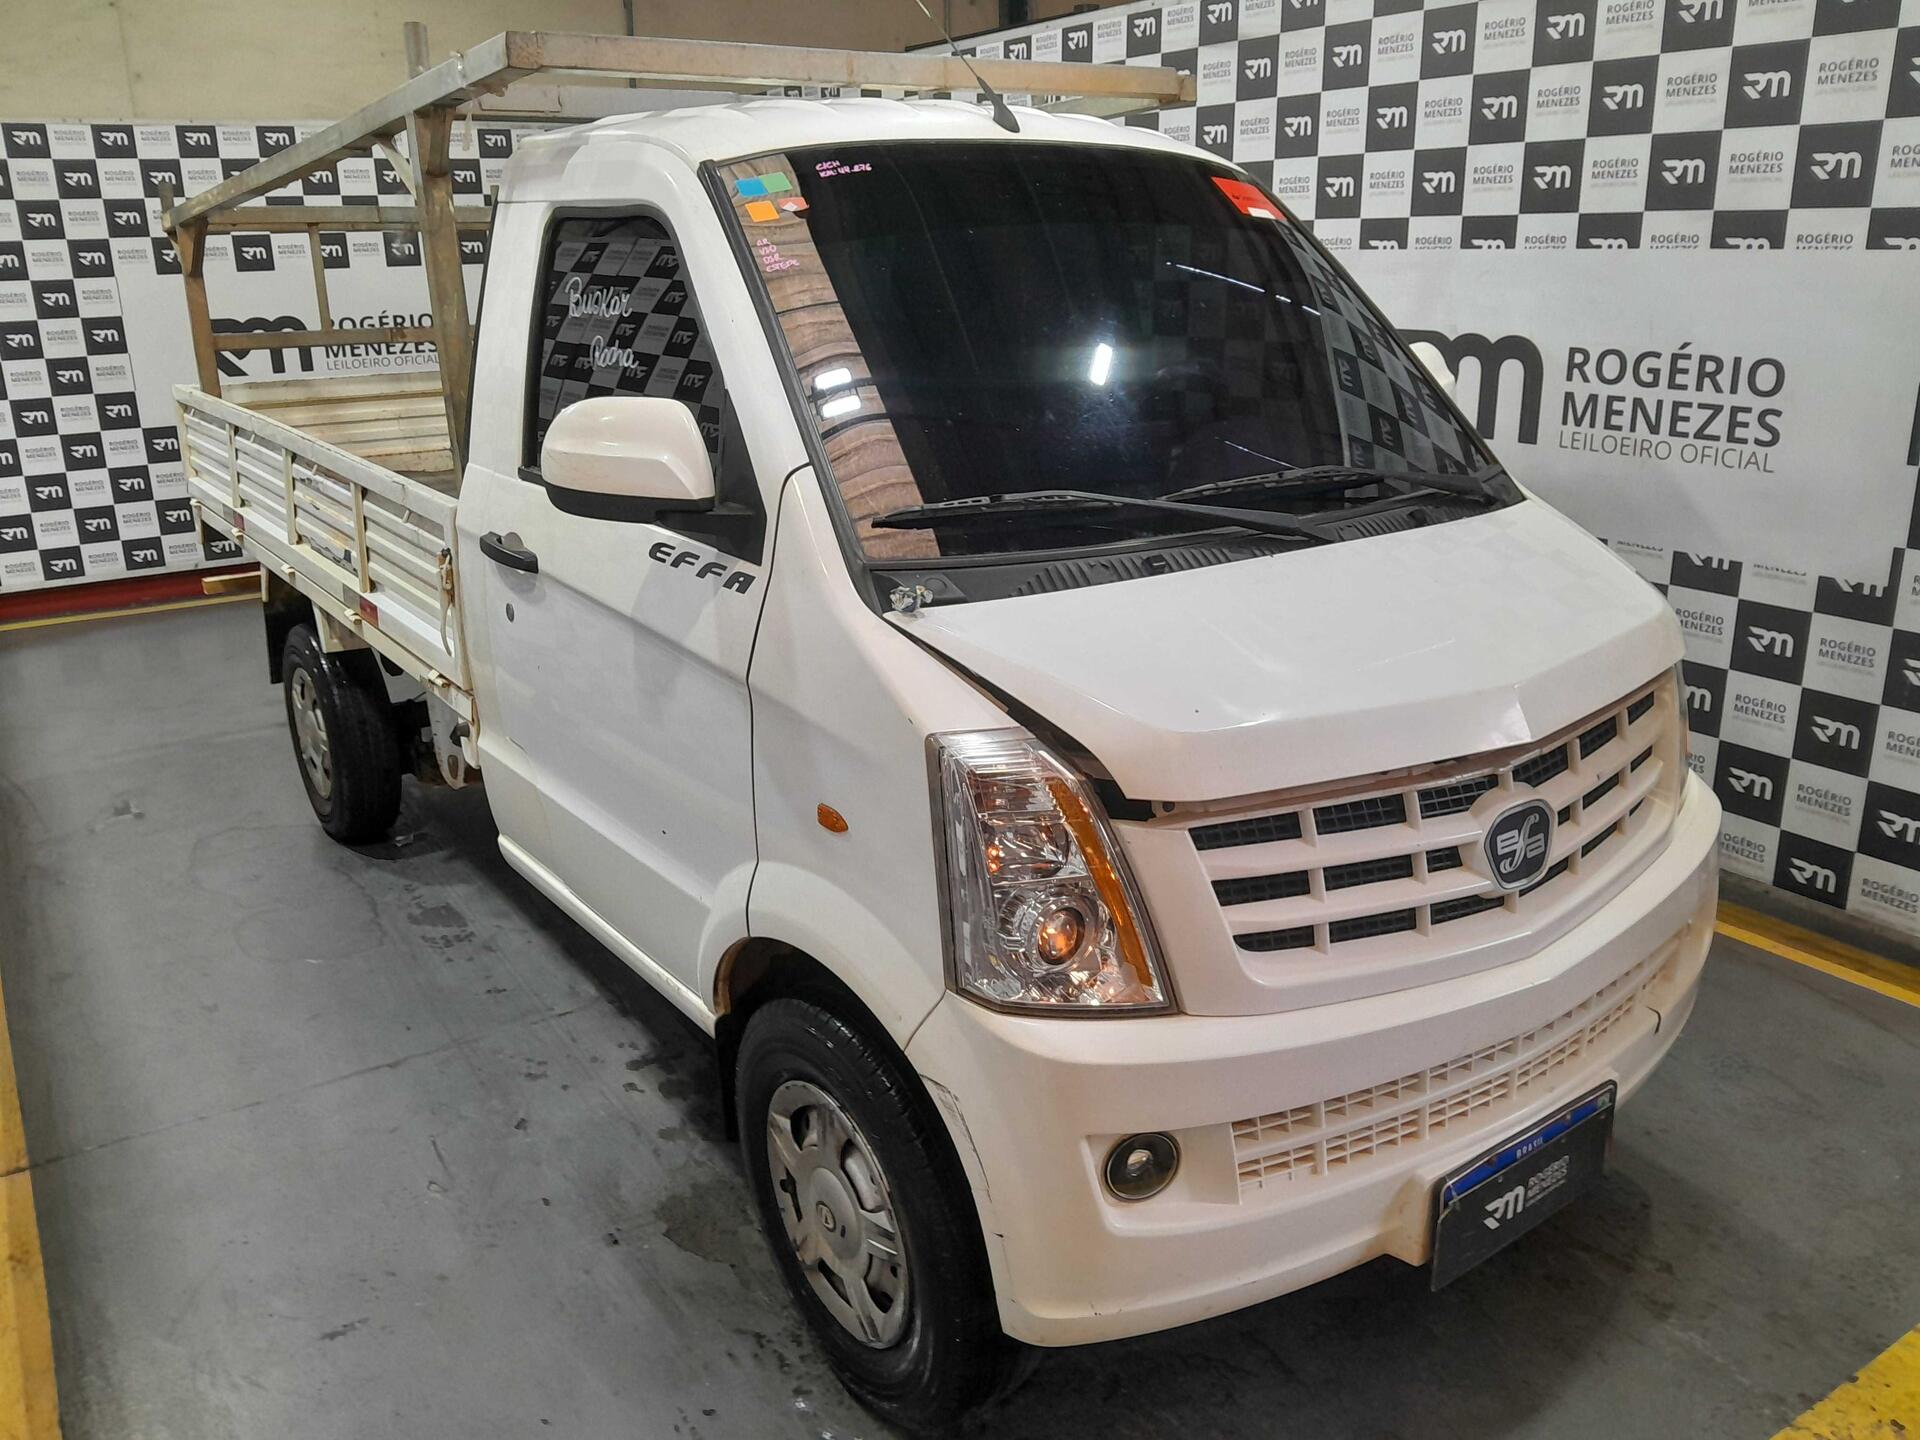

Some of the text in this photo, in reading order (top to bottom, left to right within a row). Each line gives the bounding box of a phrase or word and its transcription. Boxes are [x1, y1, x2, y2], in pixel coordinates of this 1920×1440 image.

[1651, 234, 1699, 244] ROGÉRIO
[1797, 233, 1853, 244] ROGÉRIO
[327, 358, 390, 370] LEILOEIRO
[1566, 342, 1785, 397] ROGÉRIO
[1561, 391, 1783, 447] MENEZES
[1559, 430, 1775, 473] LEILOEIRO OFICIAL
[648, 542, 756, 594] EFFA
[1820, 638, 1876, 657] ROGÉRIO
[1818, 648, 1874, 668] MENEZES
[1735, 694, 1786, 713] ROGÉRIO
[1734, 704, 1786, 724] MENEZES
[1798, 784, 1851, 805] ROGÉRIO
[1797, 794, 1850, 816] MENEZES
